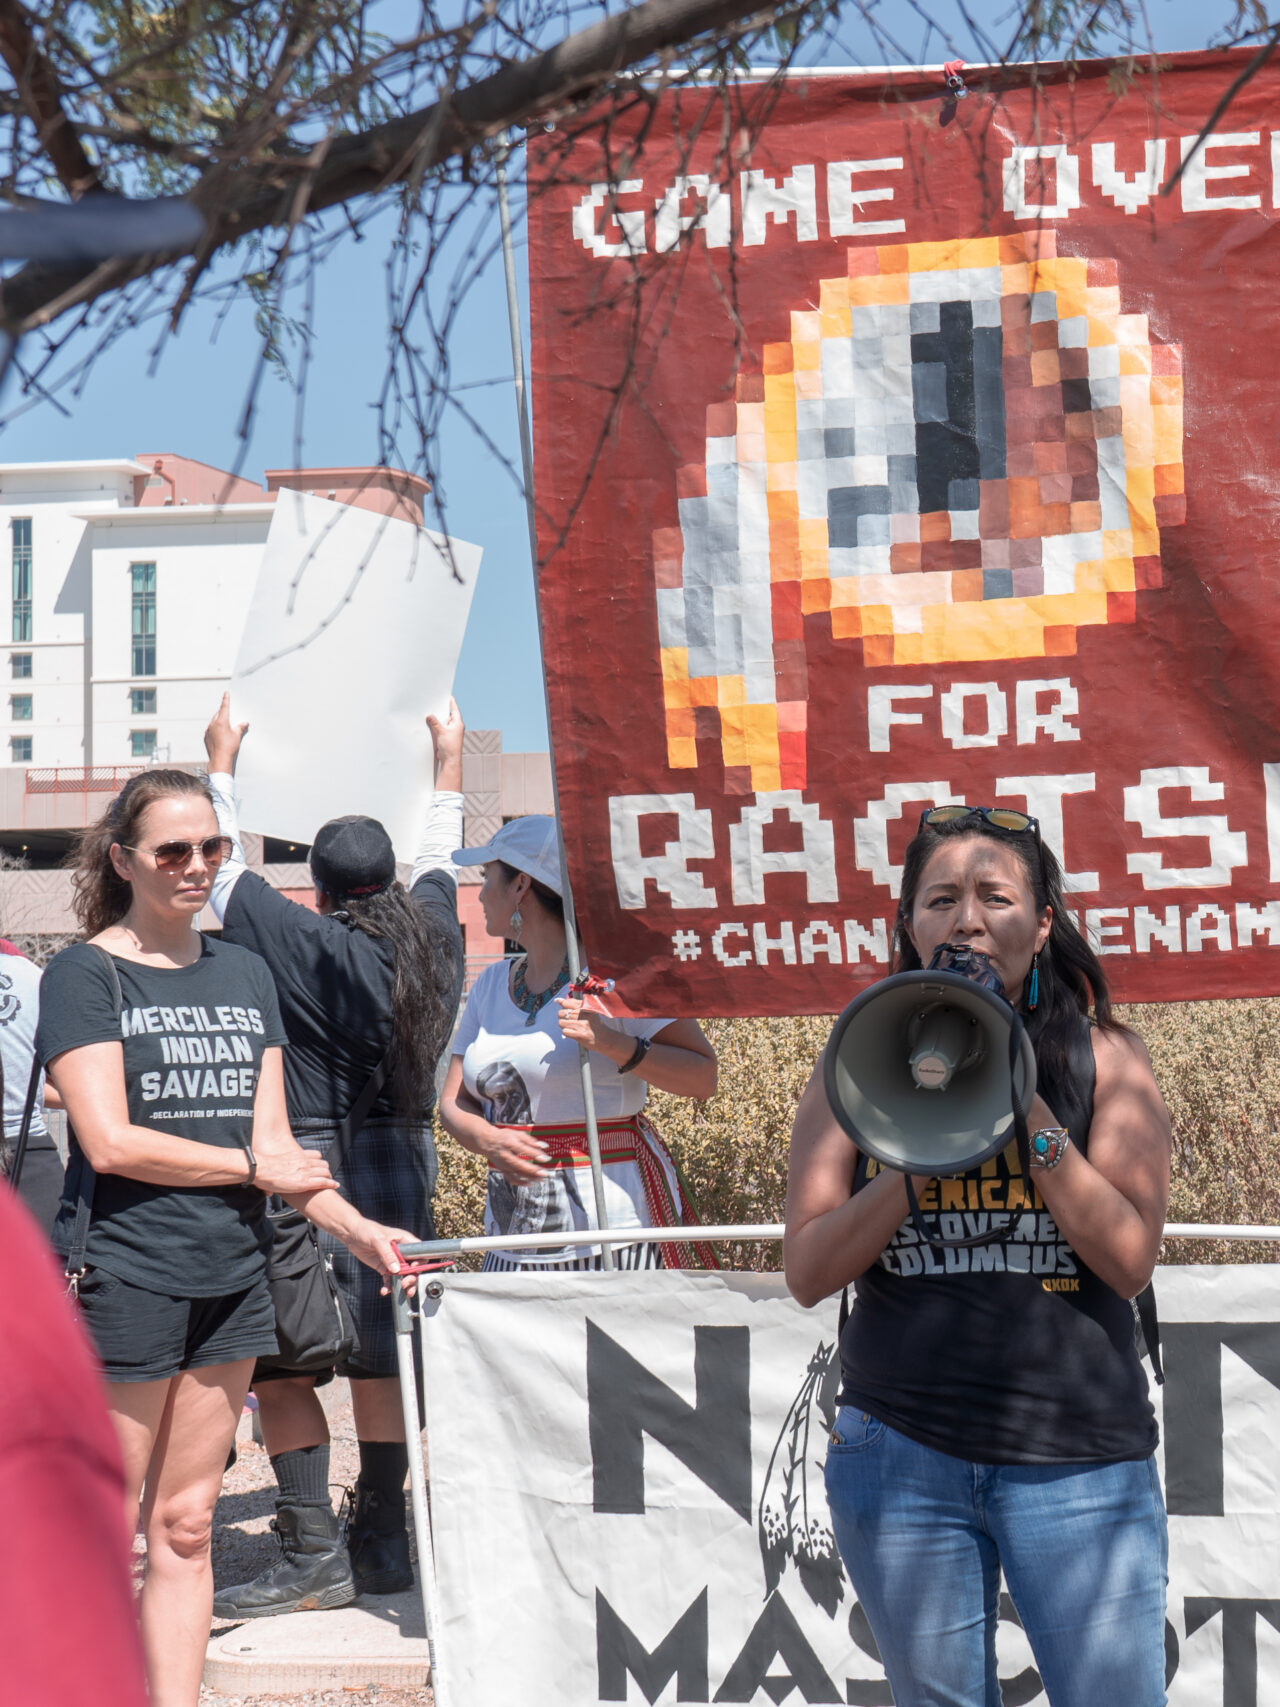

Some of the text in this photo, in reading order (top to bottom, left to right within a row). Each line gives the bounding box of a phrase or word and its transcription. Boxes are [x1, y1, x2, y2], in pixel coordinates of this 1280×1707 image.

[572, 156, 906, 257] GAME
[867, 677, 1081, 752] FOR
[121, 1006, 265, 1037] MERCILESS
[160, 1036, 254, 1064] INDIAN
[206, 1109, 216, 1118] OF
[880, 1243, 1077, 1277] COLUMBUS
